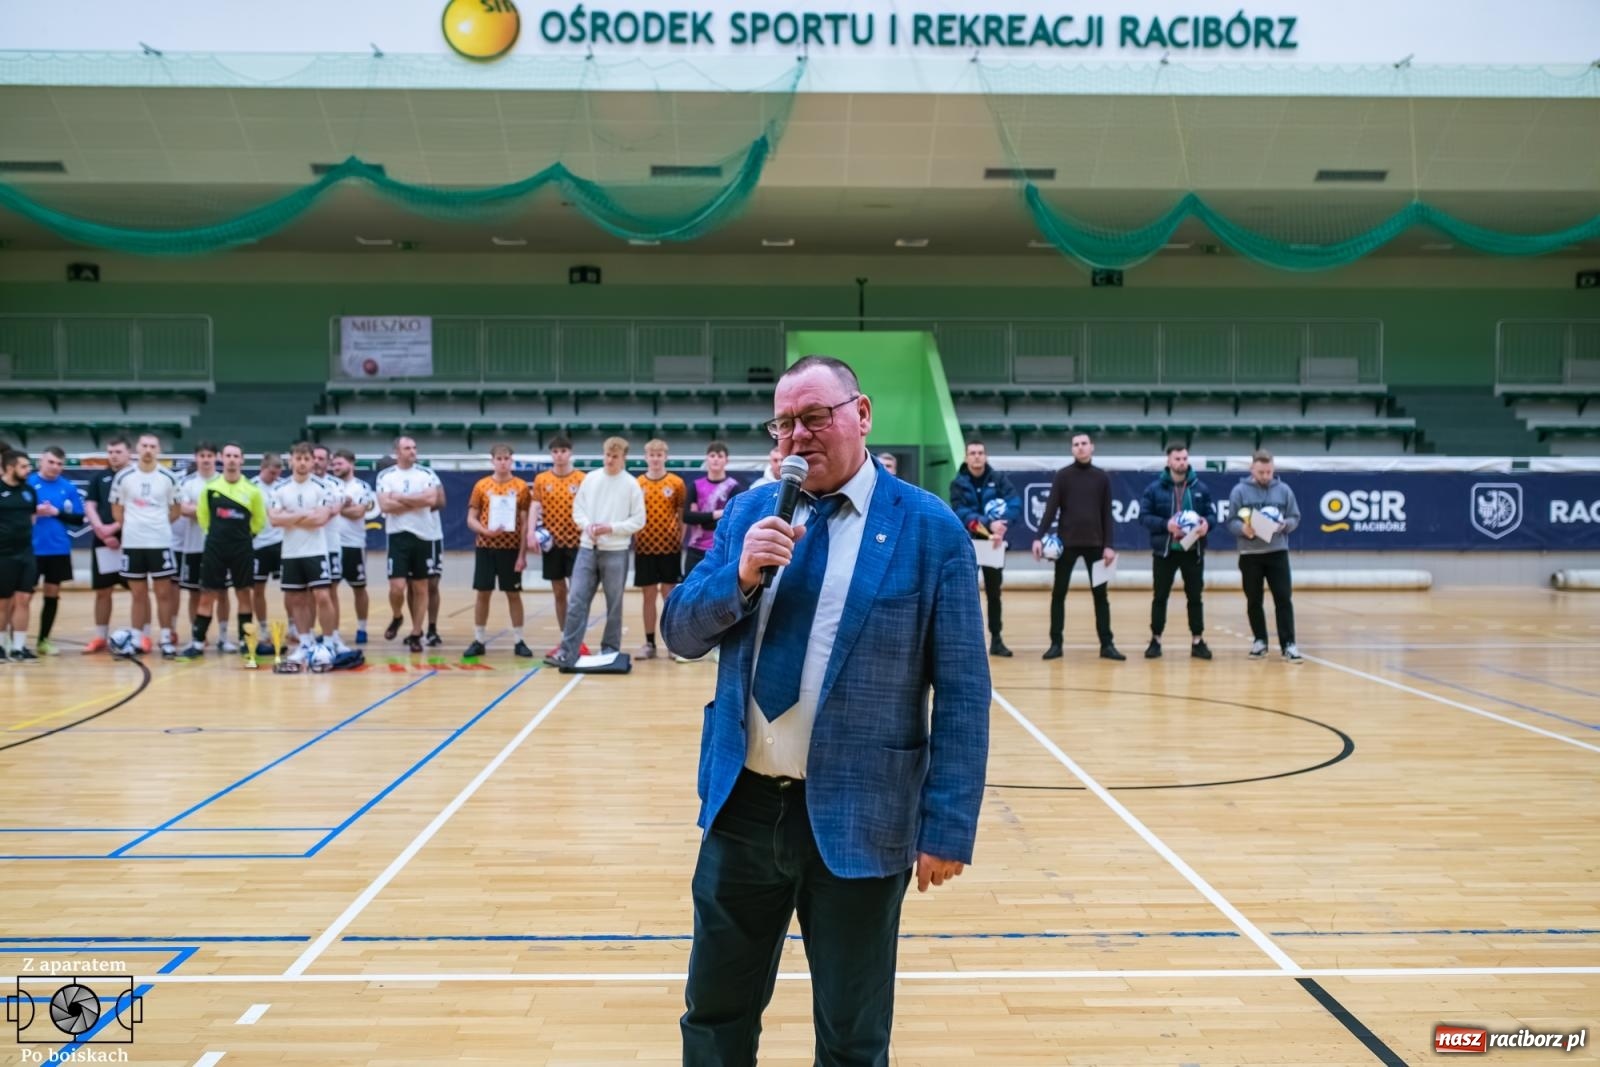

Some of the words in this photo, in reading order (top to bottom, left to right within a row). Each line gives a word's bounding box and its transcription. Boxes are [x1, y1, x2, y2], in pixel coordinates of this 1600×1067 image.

[540, 4, 714, 44] OŚRODEK
[730, 11, 874, 45] SPORTU
[890, 14, 897, 45] I
[913, 14, 1103, 47] REKREACJI
[1119, 10, 1299, 49] RACIBÓRZ
[351, 319, 422, 332] MIESZKO
[1353, 521, 1407, 532] RACIBÓRZ
